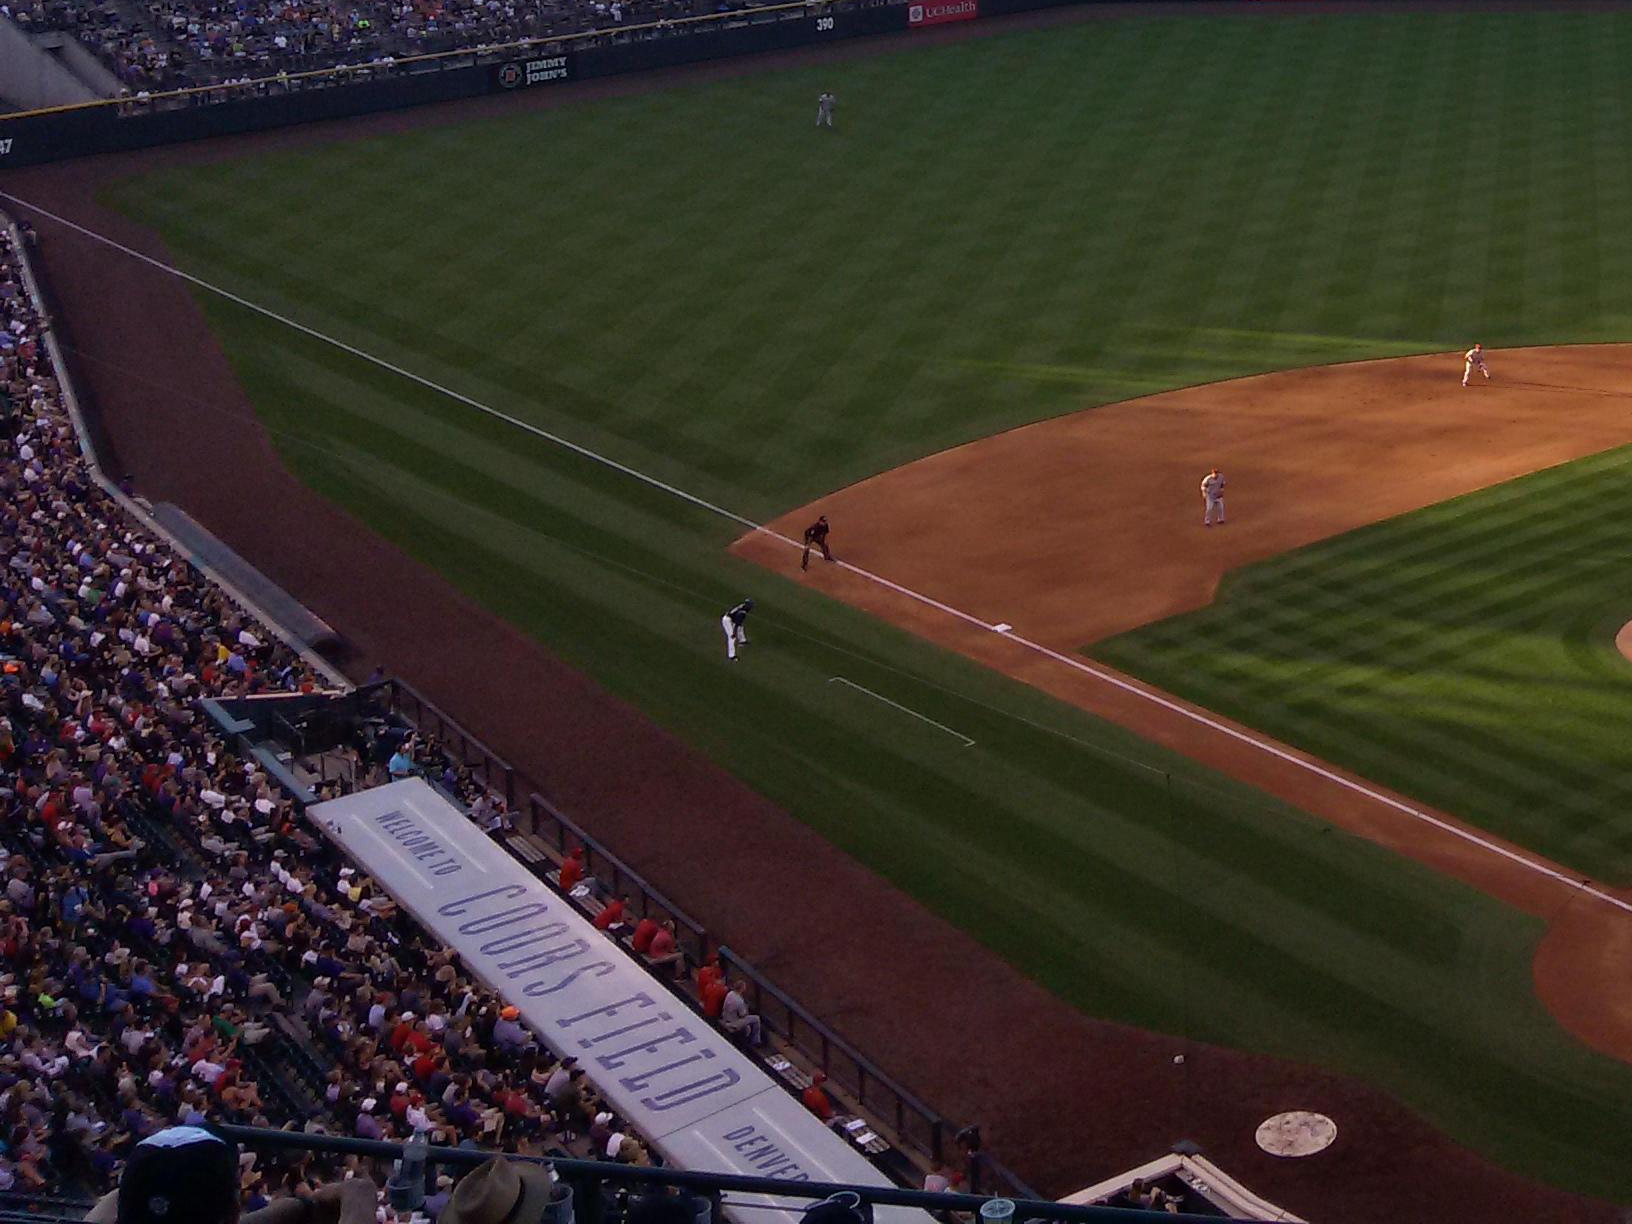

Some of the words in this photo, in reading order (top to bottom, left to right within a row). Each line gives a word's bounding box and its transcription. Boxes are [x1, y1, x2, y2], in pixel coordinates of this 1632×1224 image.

[925, 1, 976, 18] UCHealth
[816, 17, 834, 31] 390
[526, 56, 567, 74] JIMMY
[526, 68, 568, 85] JOHN'S
[375, 810, 445, 861] WELCOME
[428, 858, 462, 876] TO
[437, 883, 616, 998] COORS
[555, 990, 742, 1113] FIELD
